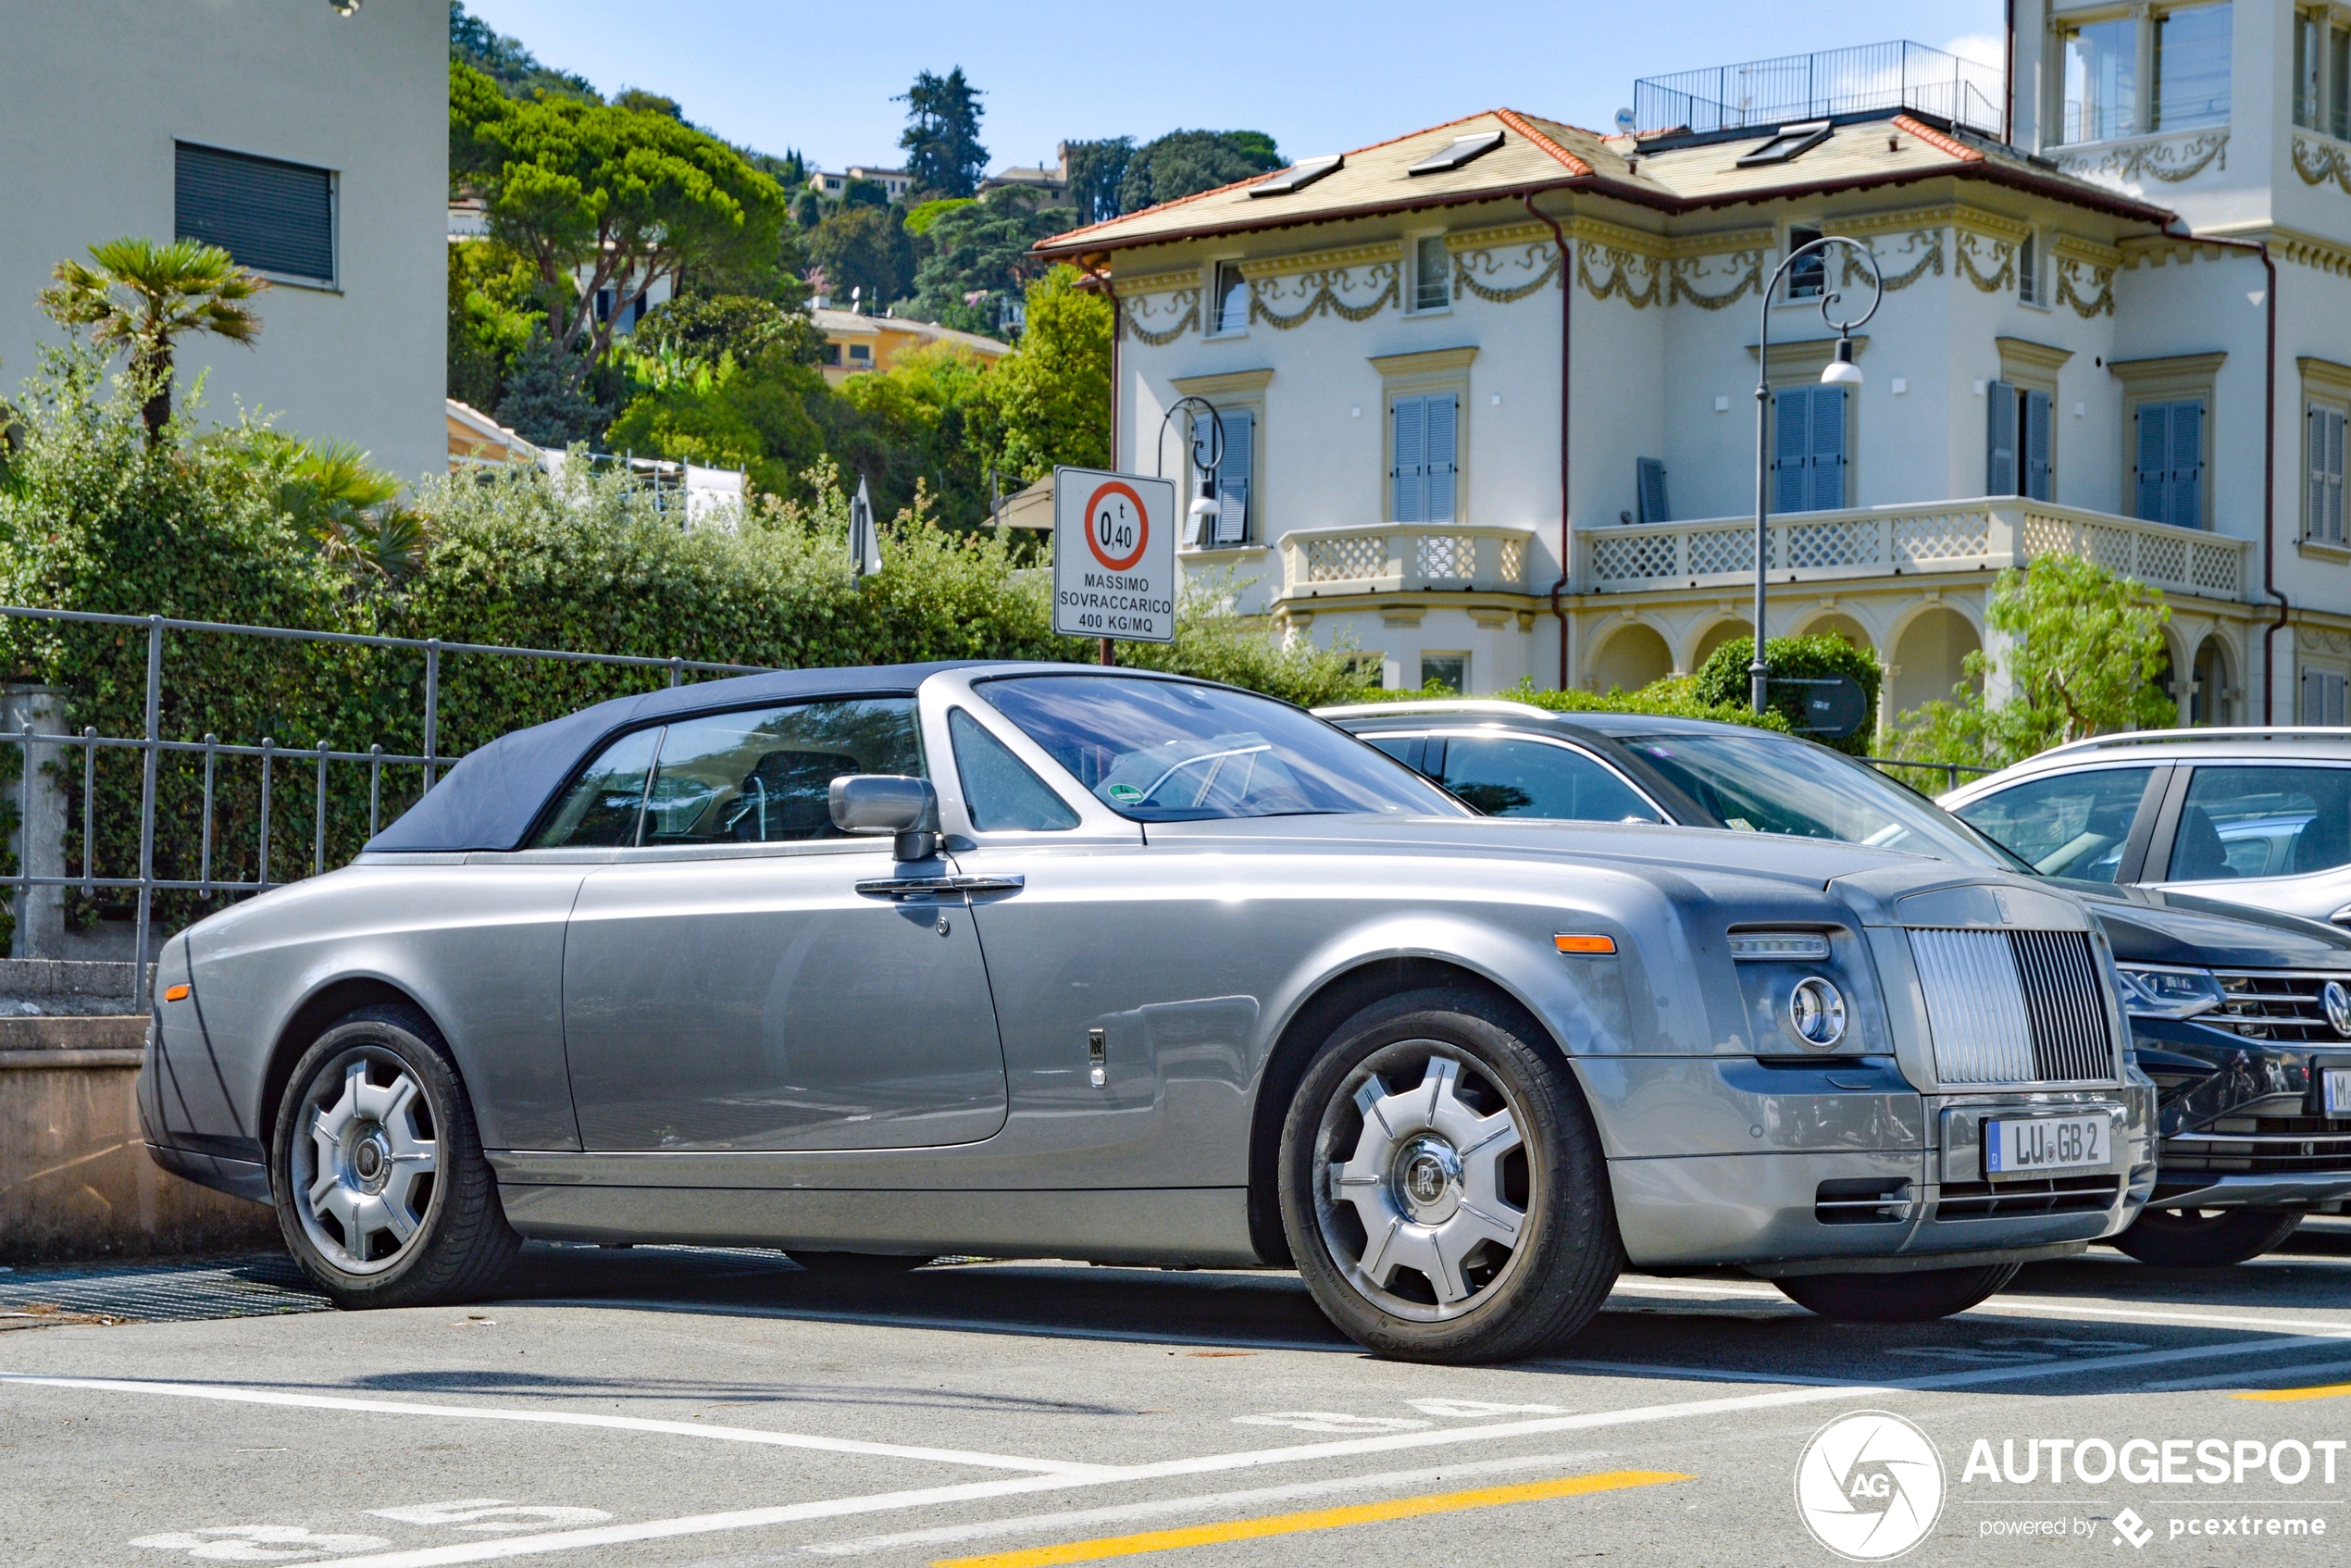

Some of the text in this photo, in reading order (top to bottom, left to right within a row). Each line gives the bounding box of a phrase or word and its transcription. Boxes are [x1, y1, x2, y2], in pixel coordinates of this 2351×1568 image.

[1119, 503, 1125, 519] t
[1100, 511, 1132, 551] 0,40
[1085, 573, 1149, 592] MASSIMO
[1060, 591, 1171, 615] SOVRACCARICO
[1078, 613, 1153, 633] 400 KG/MQ
[2334, 1076, 2346, 1106] M
[1991, 1122, 2098, 1165] D LU GB 2
[1885, 1337, 2152, 1363] 83
[1229, 1398, 1580, 1433] 84
[127, 1497, 615, 1562] 85
